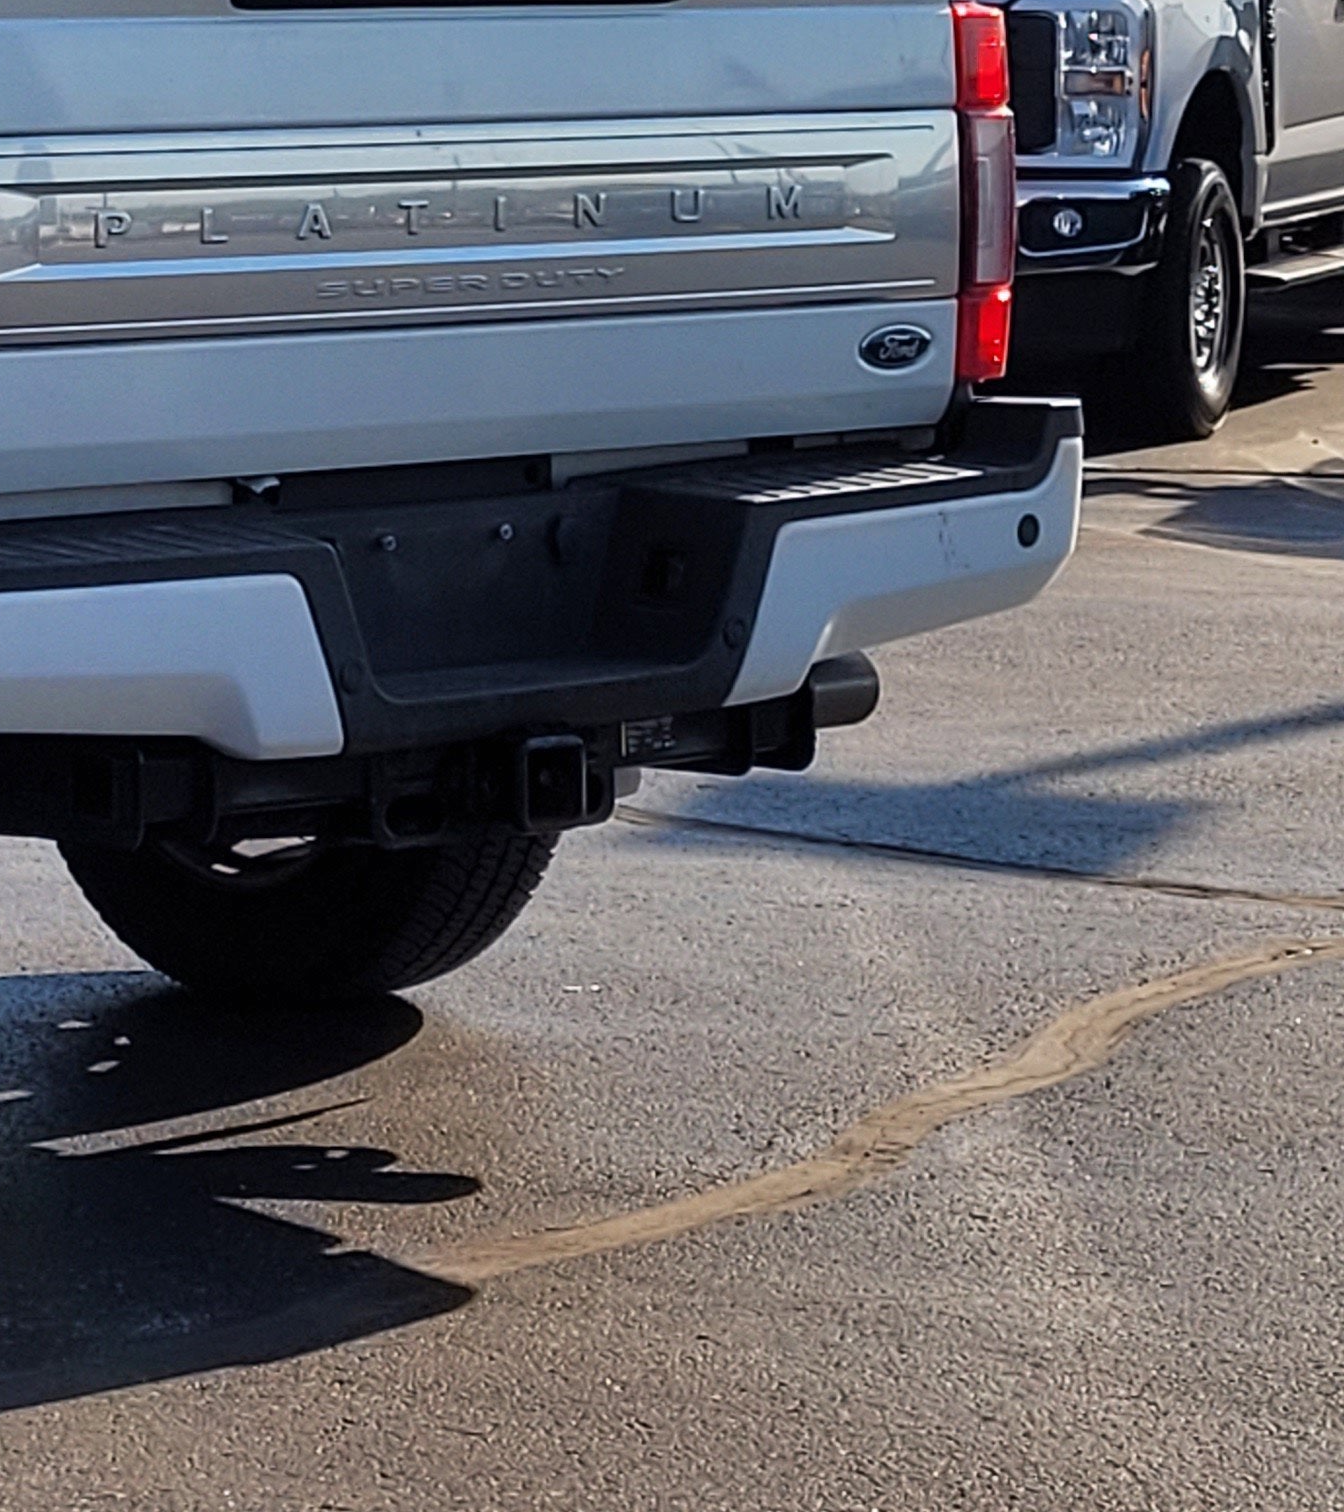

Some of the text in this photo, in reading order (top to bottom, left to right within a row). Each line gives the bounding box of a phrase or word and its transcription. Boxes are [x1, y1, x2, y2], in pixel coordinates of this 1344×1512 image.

[93, 183, 802, 248] PLATINUM
[315, 266, 625, 298] SUPER DUTY
[878, 333, 921, 361] Ford
